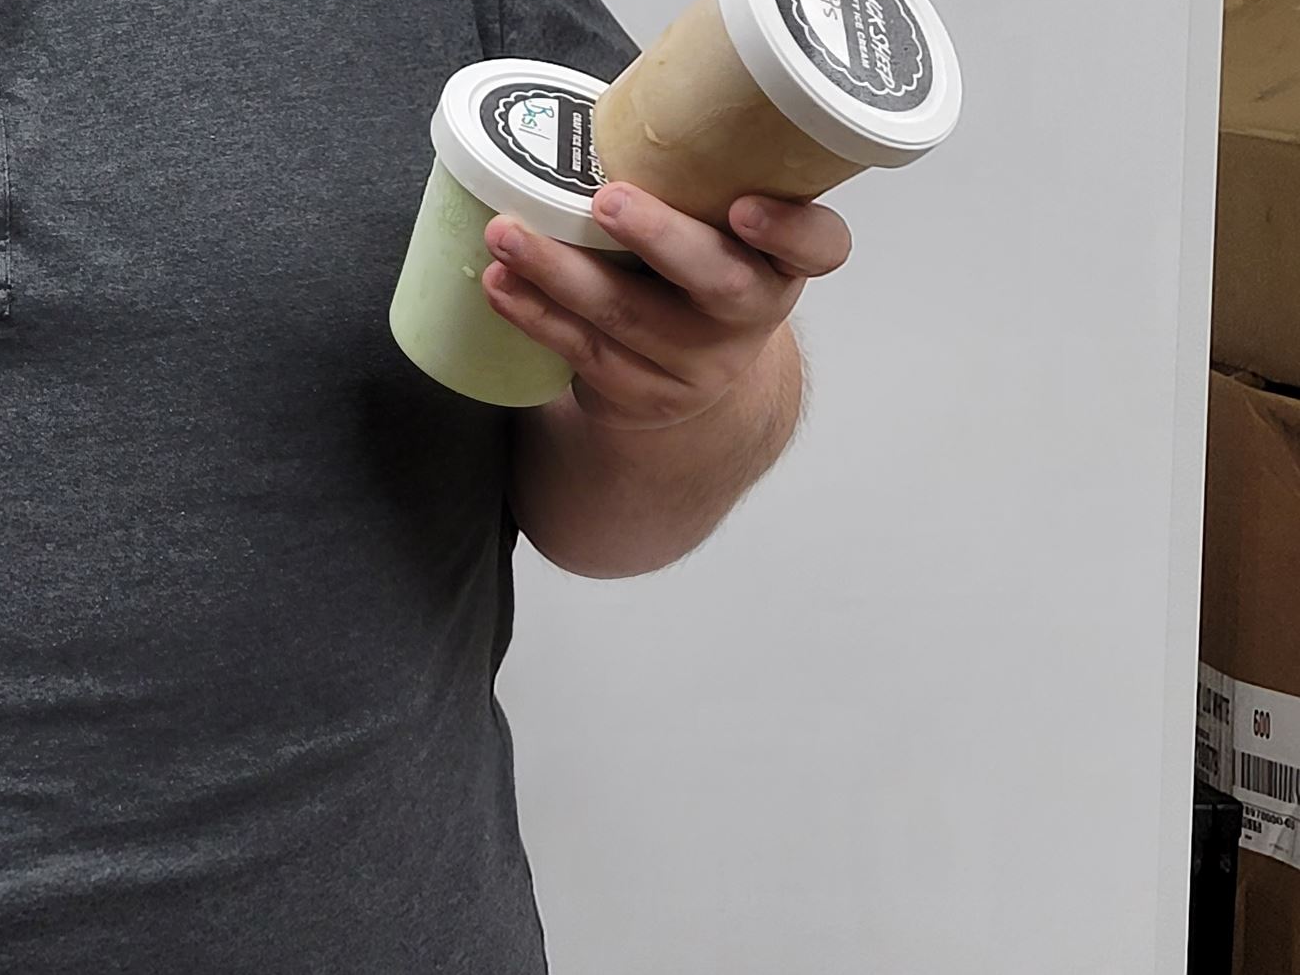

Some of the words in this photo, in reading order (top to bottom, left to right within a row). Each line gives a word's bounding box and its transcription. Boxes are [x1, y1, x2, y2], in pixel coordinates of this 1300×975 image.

[853, 12, 864, 30] ICE
[857, 31, 870, 69] CREAM
[869, 25, 895, 88] SHEEP
[518, 100, 555, 140] Basil
